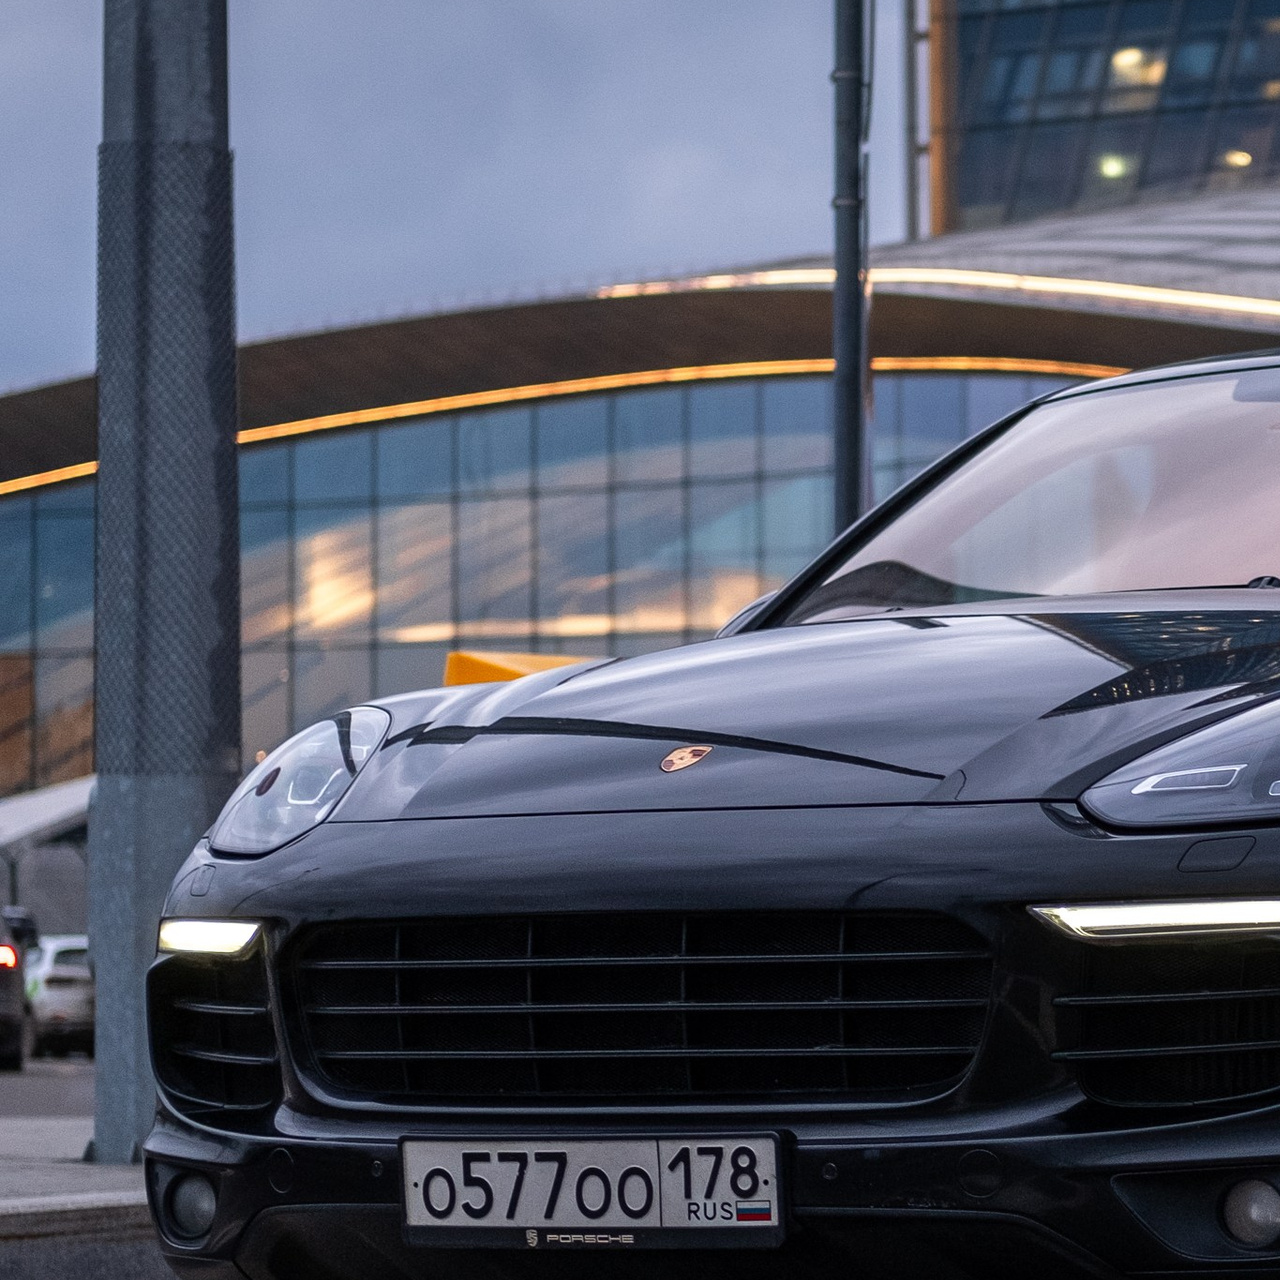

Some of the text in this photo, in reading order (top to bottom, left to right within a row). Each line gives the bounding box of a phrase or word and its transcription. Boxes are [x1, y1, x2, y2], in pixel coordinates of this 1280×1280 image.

[667, 1145, 759, 1200] 178
[687, 1202, 734, 1221] RUS
[546, 1234, 635, 1244] PORSCHE
